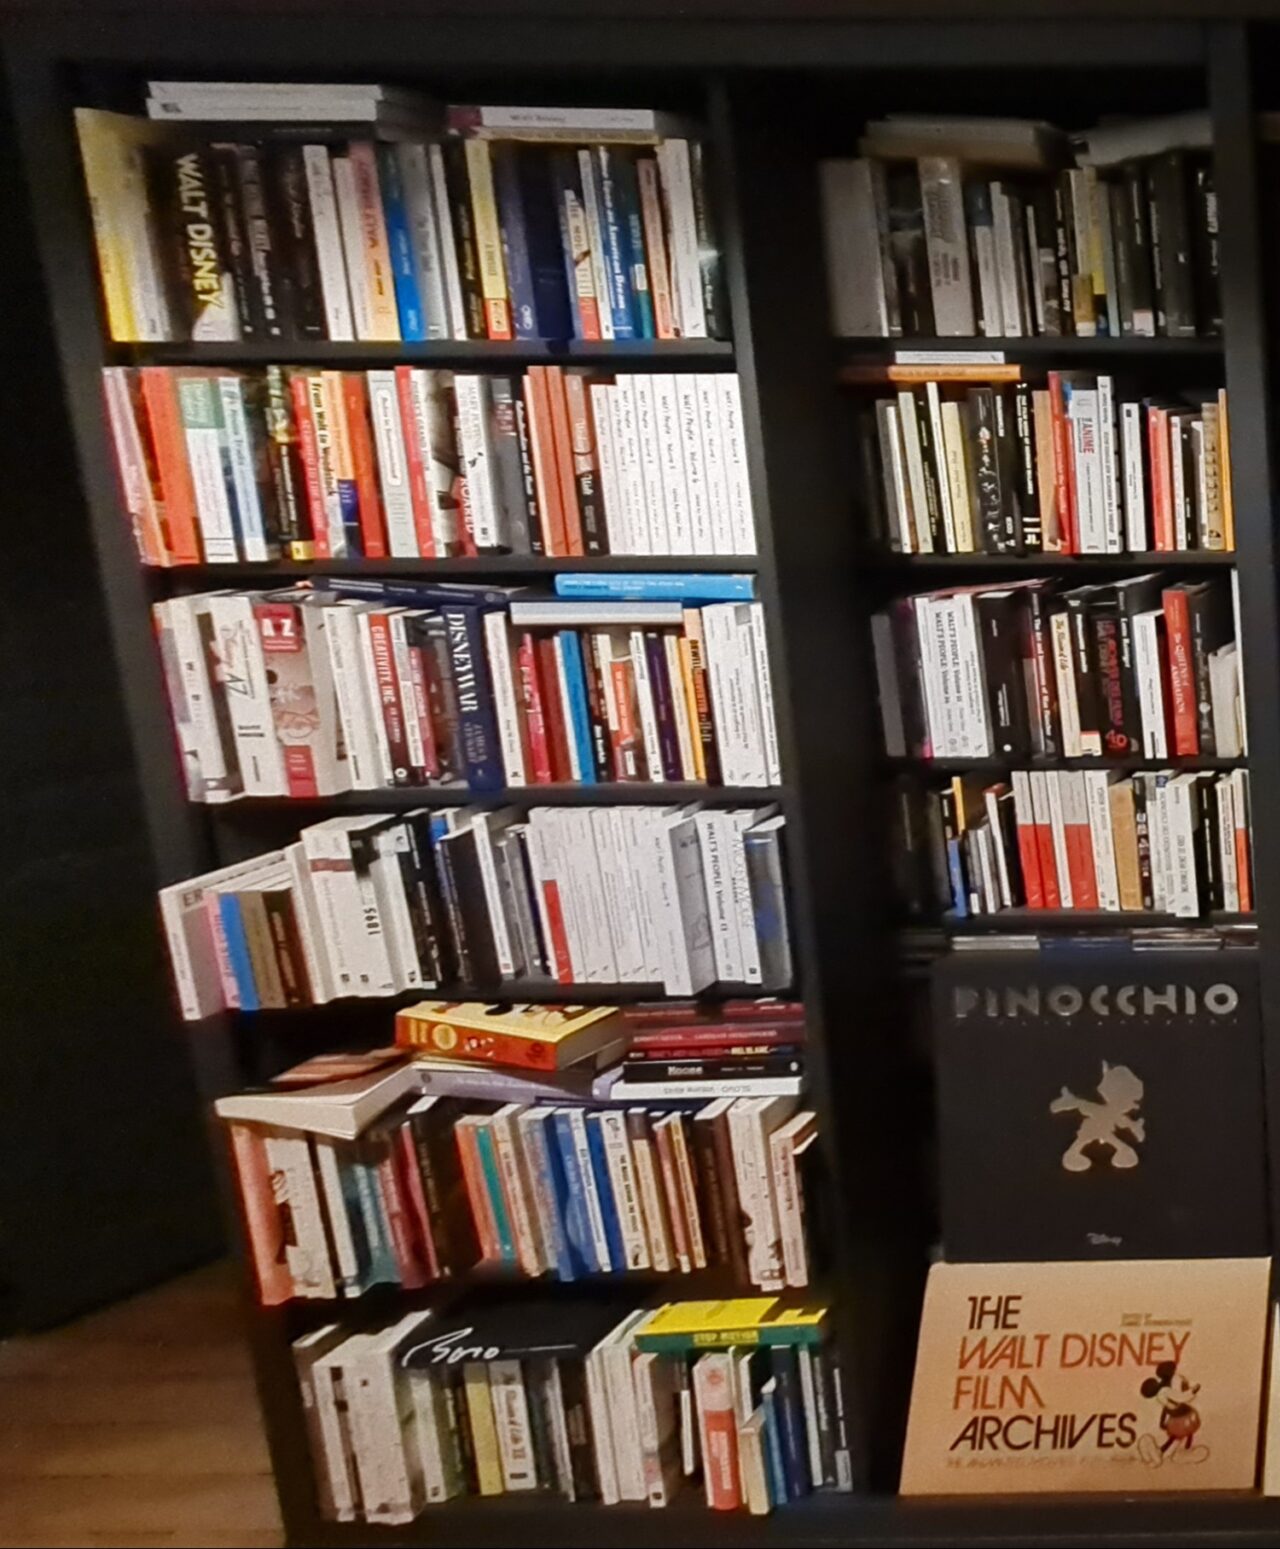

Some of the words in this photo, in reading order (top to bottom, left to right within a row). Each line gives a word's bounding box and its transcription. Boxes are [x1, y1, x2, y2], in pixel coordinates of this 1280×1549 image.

[174, 152, 207, 226] WALT
[187, 223, 224, 309] DISNEY
[617, 275, 626, 310] Dream
[684, 417, 695, 441] People
[688, 451, 699, 475] Volume
[446, 612, 479, 713] DISNEYWAR
[930, 611, 945, 639] WALT'S
[938, 669, 951, 695] Volume
[944, 610, 958, 638] WALT'S
[951, 668, 965, 695] Volume
[705, 821, 718, 852] WALT'S
[714, 889, 728, 920] Volume
[955, 983, 1239, 1018] PINOCCHIO
[968, 1295, 1022, 1330] THE
[958, 1334, 1050, 1369] WALT
[1060, 1331, 1191, 1369] DISNEY
[952, 1375, 1045, 1410] FILM
[950, 1413, 1138, 1451] ARCHIVES
